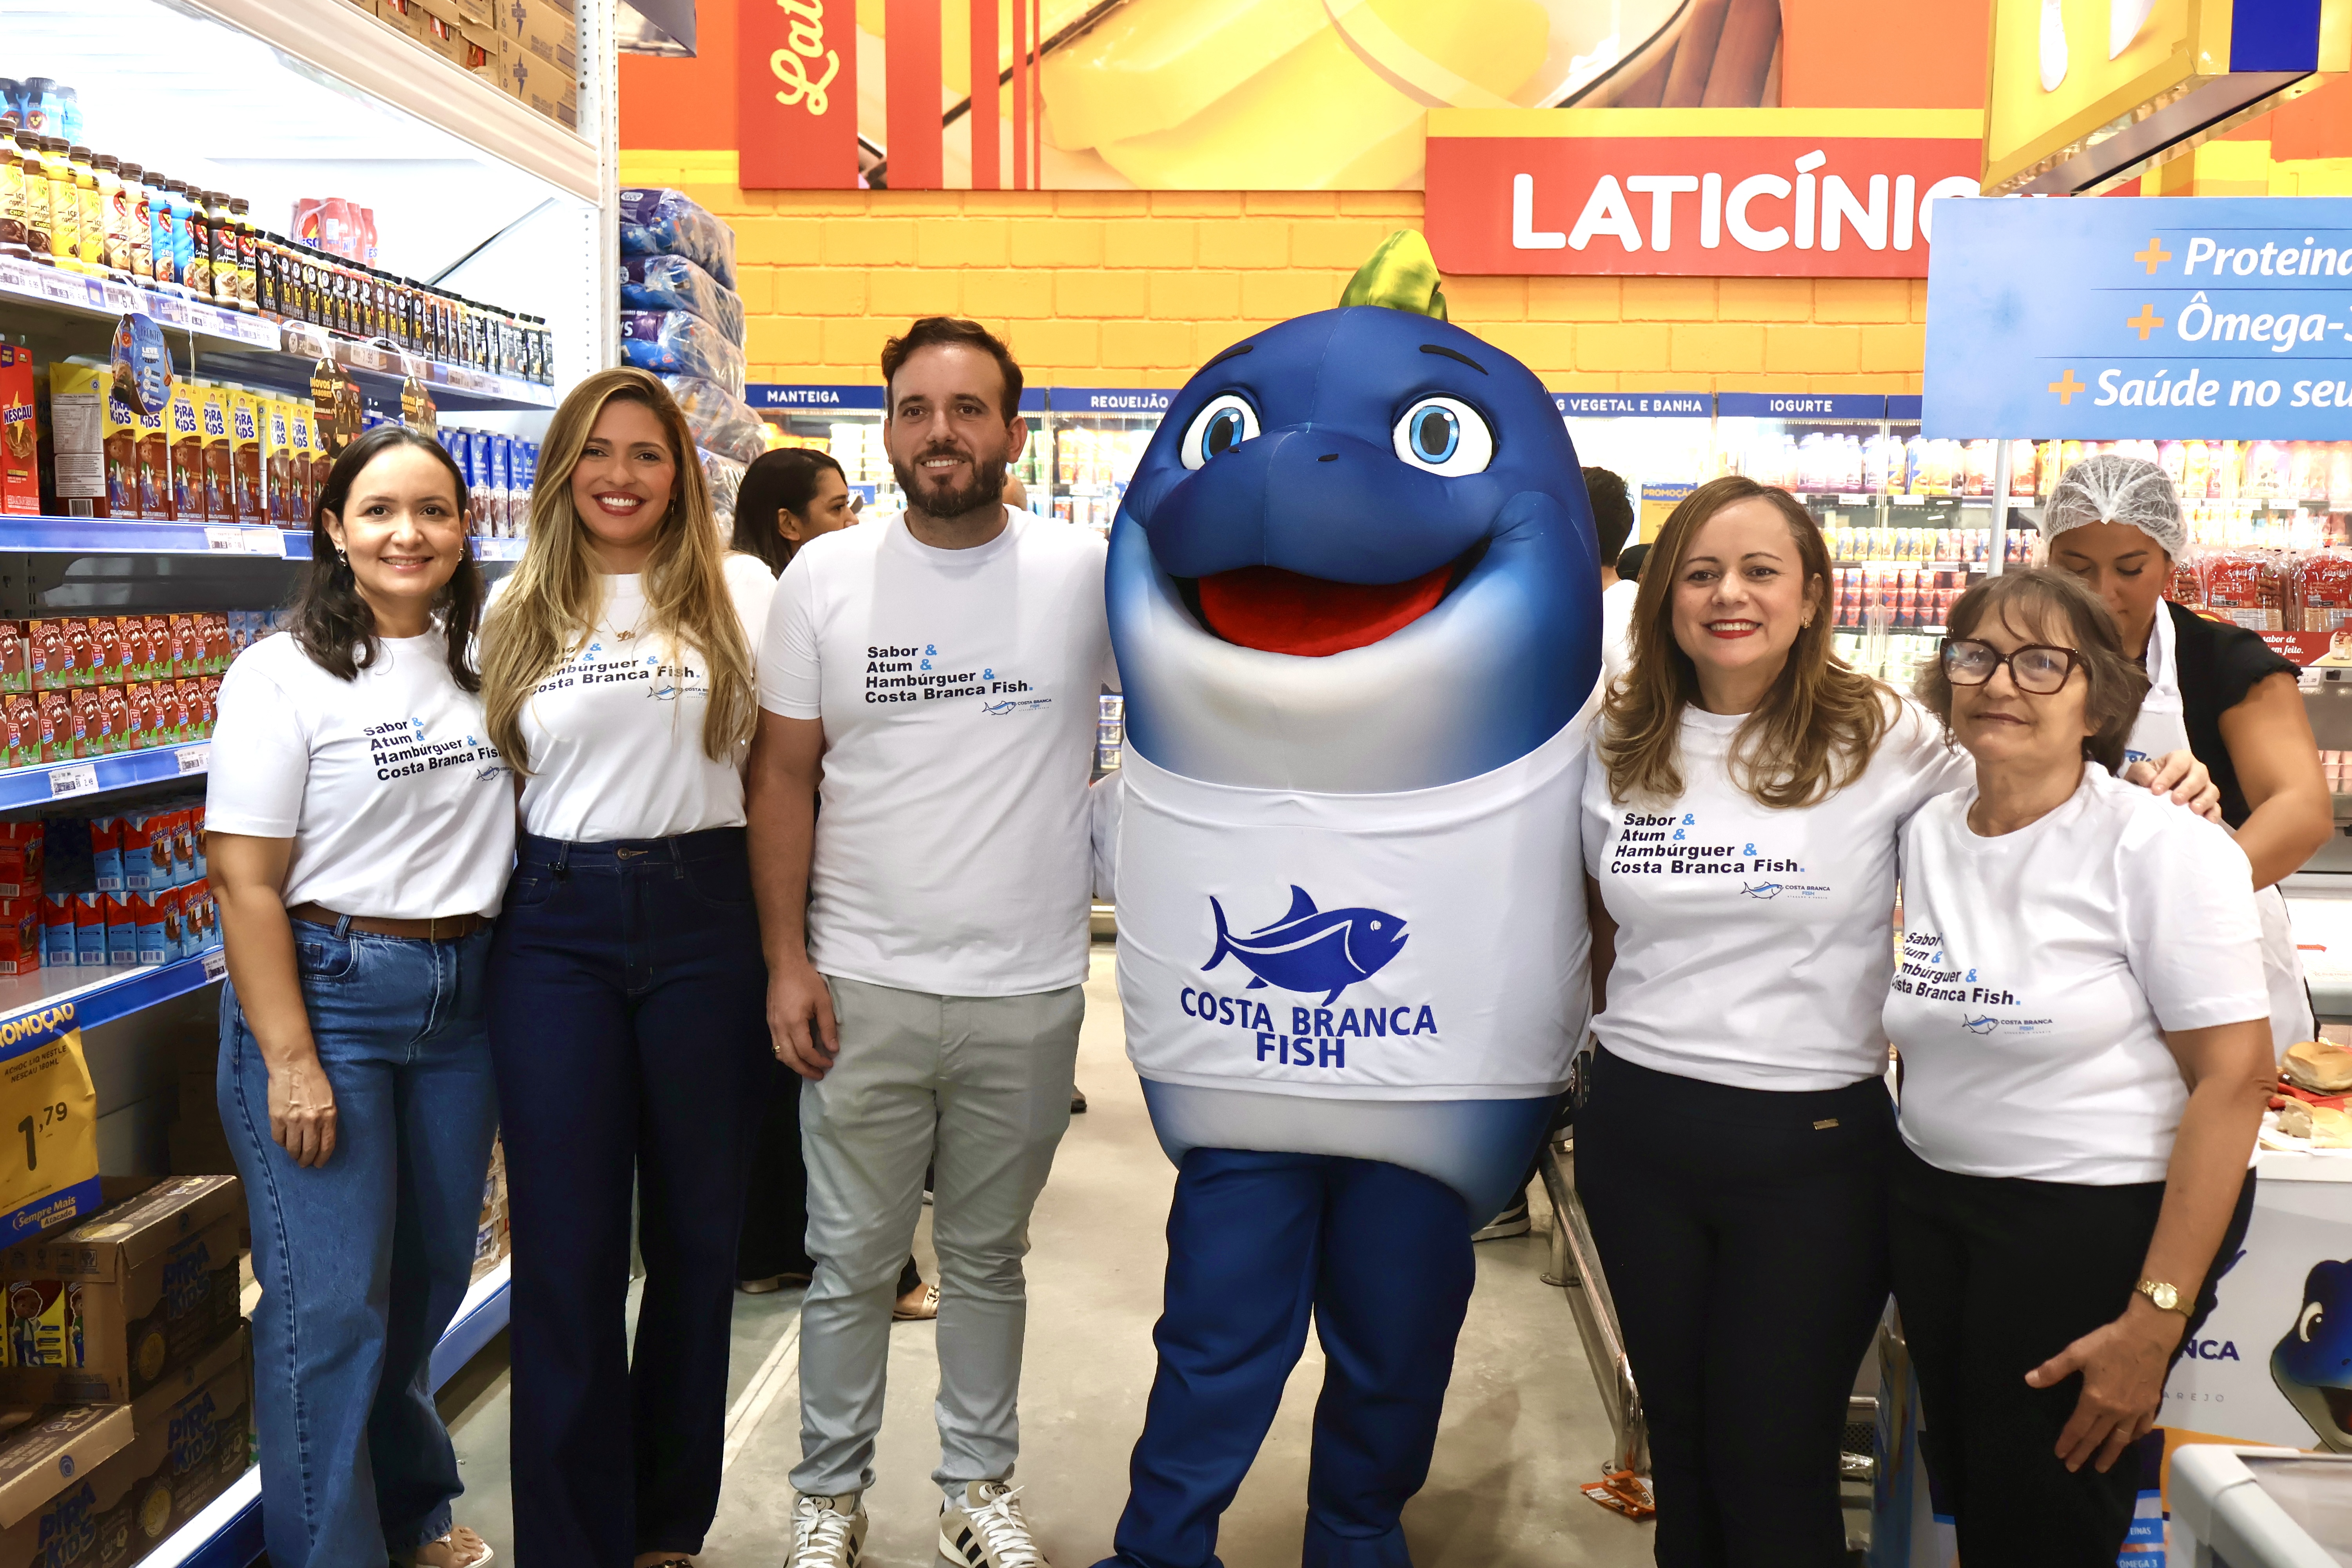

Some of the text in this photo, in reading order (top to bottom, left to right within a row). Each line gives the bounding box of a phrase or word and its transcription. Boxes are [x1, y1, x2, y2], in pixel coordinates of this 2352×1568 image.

[2094, 368, 2220, 407] Saúde
[2230, 380, 2281, 407] no
[767, 390, 840, 403] MANTEIGA
[1090, 392, 1168, 409] REQUEIJÃO
[1570, 398, 1635, 411] VEGETAL
[1639, 399, 1649, 412] E
[1653, 399, 1702, 412] BANHA
[4, 405, 33, 424] NESCAU
[1770, 399, 1833, 413] IOGURTE
[2286, 635, 2296, 643] de
[867, 646, 918, 659] Sabor
[2282, 645, 2304, 656] feito.
[548, 659, 639, 678] mbúrguer
[866, 660, 913, 673] Atum
[532, 677, 574, 695] osta
[582, 670, 649, 684] Branca
[866, 671, 976, 688] Hambúrguer
[865, 680, 1034, 704] Costa Branca Fish.
[363, 719, 408, 737] Sabor
[370, 733, 412, 751] Atum
[373, 738, 462, 766] Hambúrguer
[377, 747, 501, 781] Costa Branca Fis
[1624, 813, 1676, 826] Sabor
[1619, 829, 1666, 842] Atum
[1615, 844, 1735, 860] Hambúrguer
[1611, 859, 1805, 874] Costa Branca Fish.
[1906, 932, 1941, 946] Sabor
[1904, 946, 1930, 961] tum
[1902, 962, 1961, 984] mbúrguer
[1916, 982, 1965, 1002] Branca
[1973, 987, 2021, 1005] Fish.
[1181, 987, 1437, 1038] COSTA BRANCA
[1257, 1031, 1345, 1069] FISH
[4, 1061, 28, 1076] ACHOC
[42, 1045, 67, 1059] NESTLE
[11, 1067, 38, 1083] NESCAU
[19, 1206, 52, 1227] Sempre
[53, 1196, 76, 1211] Mais
[44, 1209, 73, 1226] Atacado
